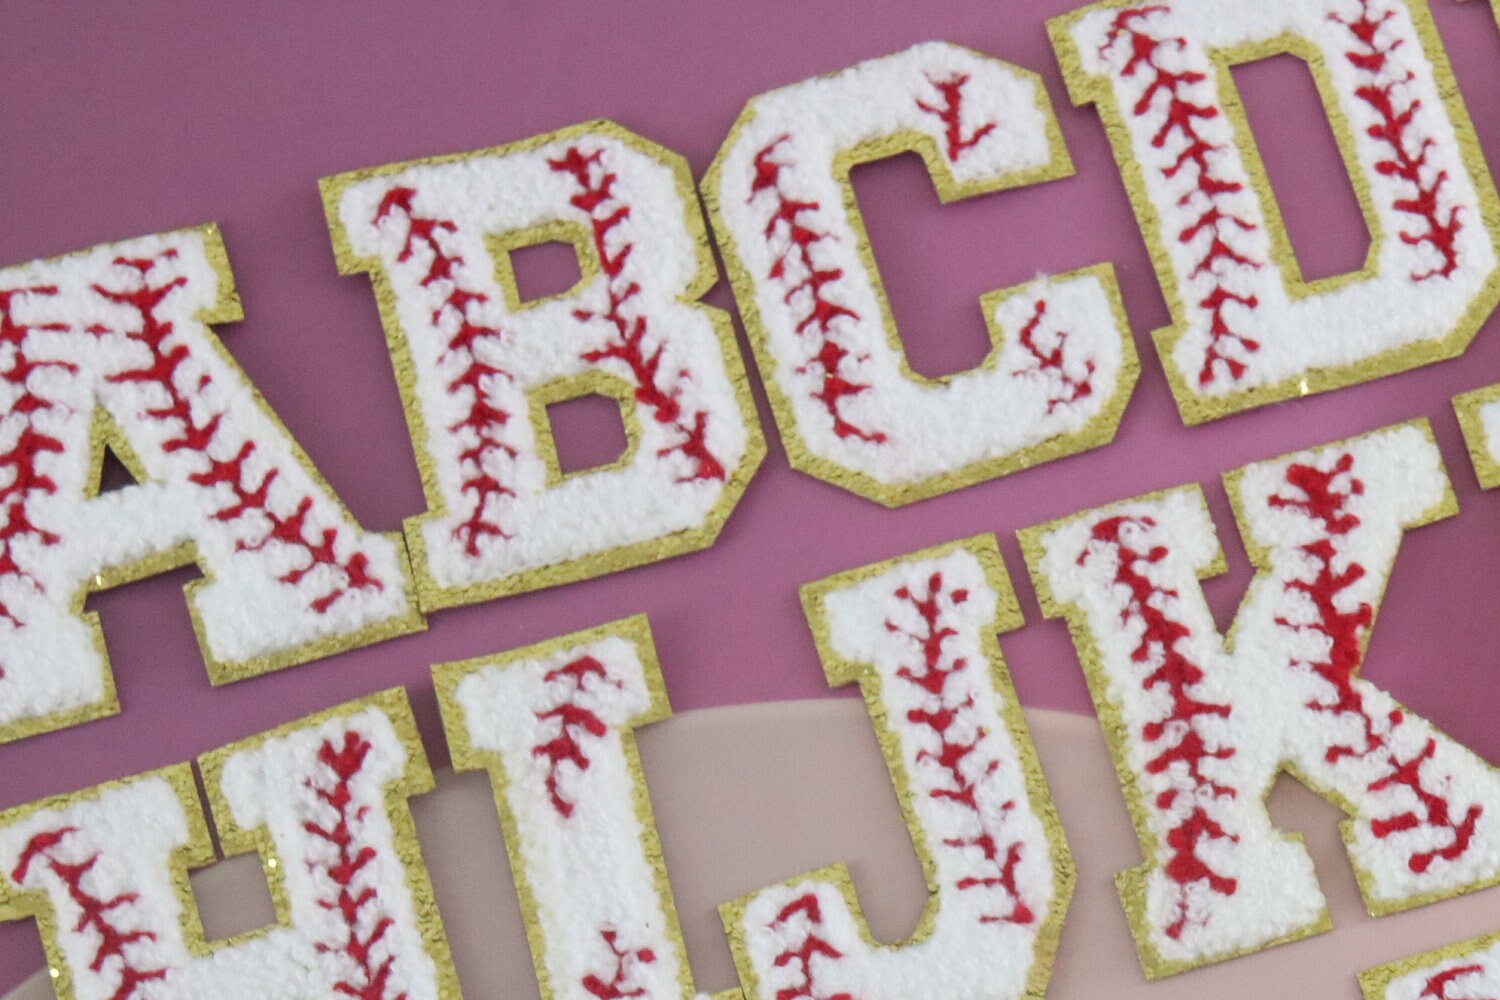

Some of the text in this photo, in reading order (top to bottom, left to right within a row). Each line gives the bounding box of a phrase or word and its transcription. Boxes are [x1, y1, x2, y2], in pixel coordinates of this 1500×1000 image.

[0, 222, 428, 742] A
[319, 119, 767, 613] B
[700, 41, 1140, 508] C
